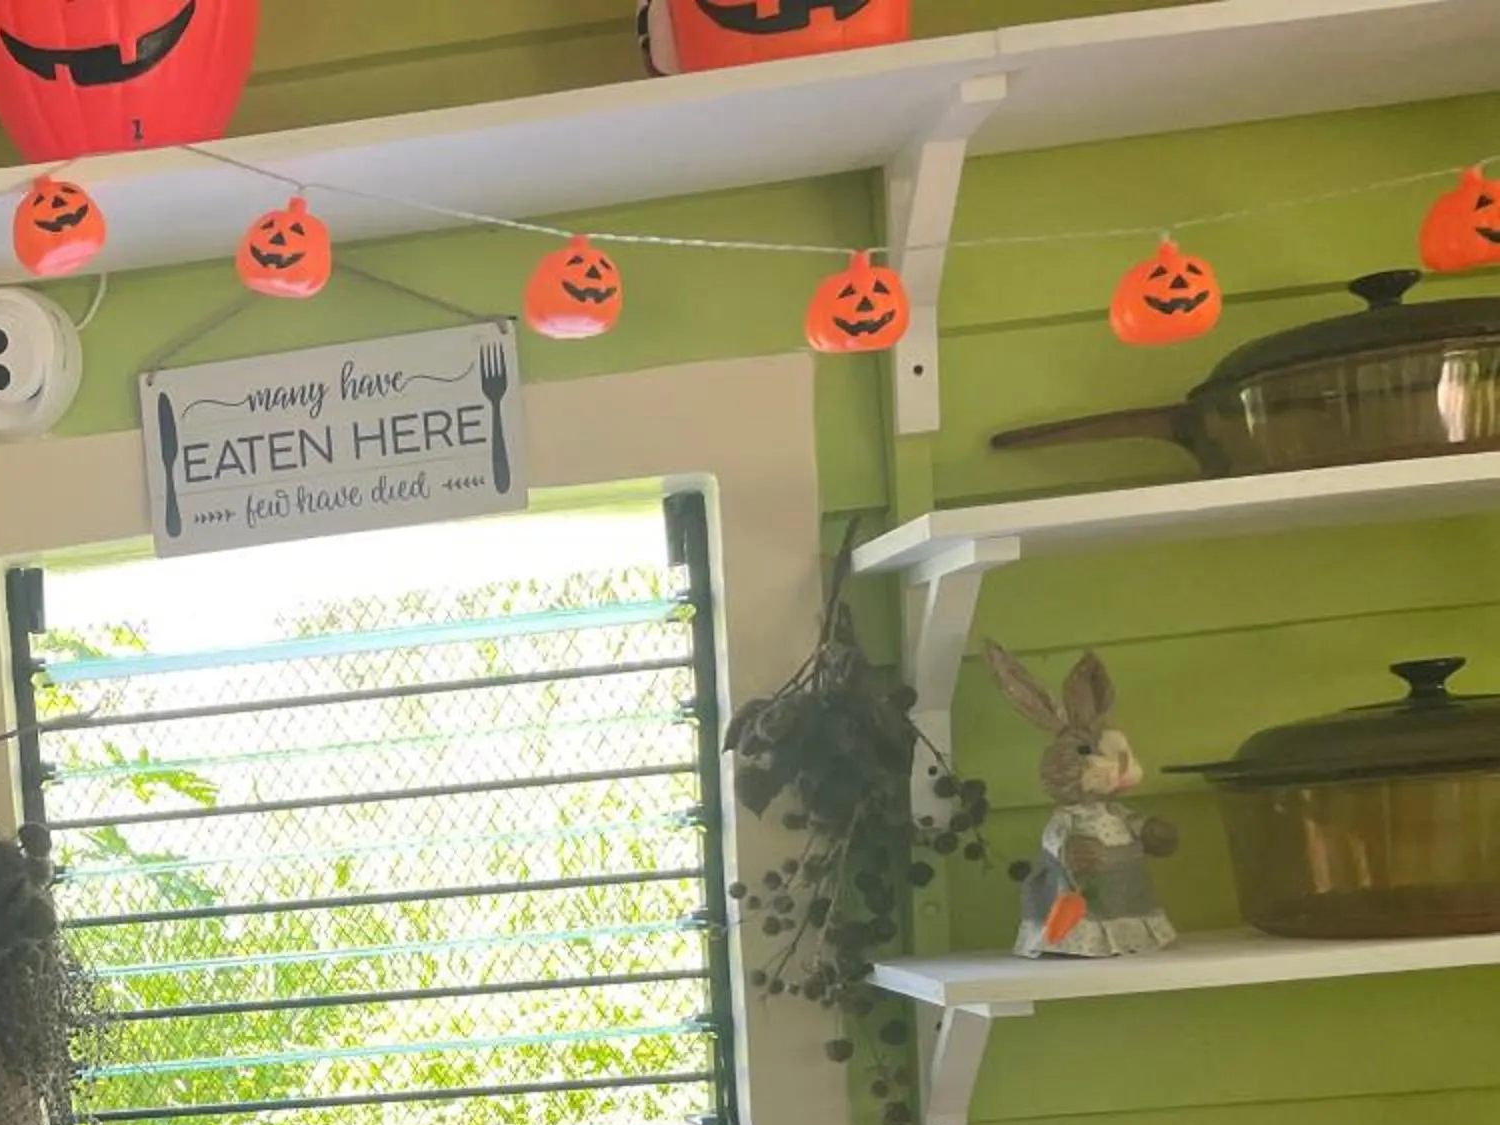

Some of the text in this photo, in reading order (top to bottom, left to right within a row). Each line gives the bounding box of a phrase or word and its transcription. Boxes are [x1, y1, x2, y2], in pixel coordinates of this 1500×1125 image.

[245, 360, 407, 418] many have
[182, 404, 487, 483] EATEN HERE
[245, 471, 431, 529] few have died
